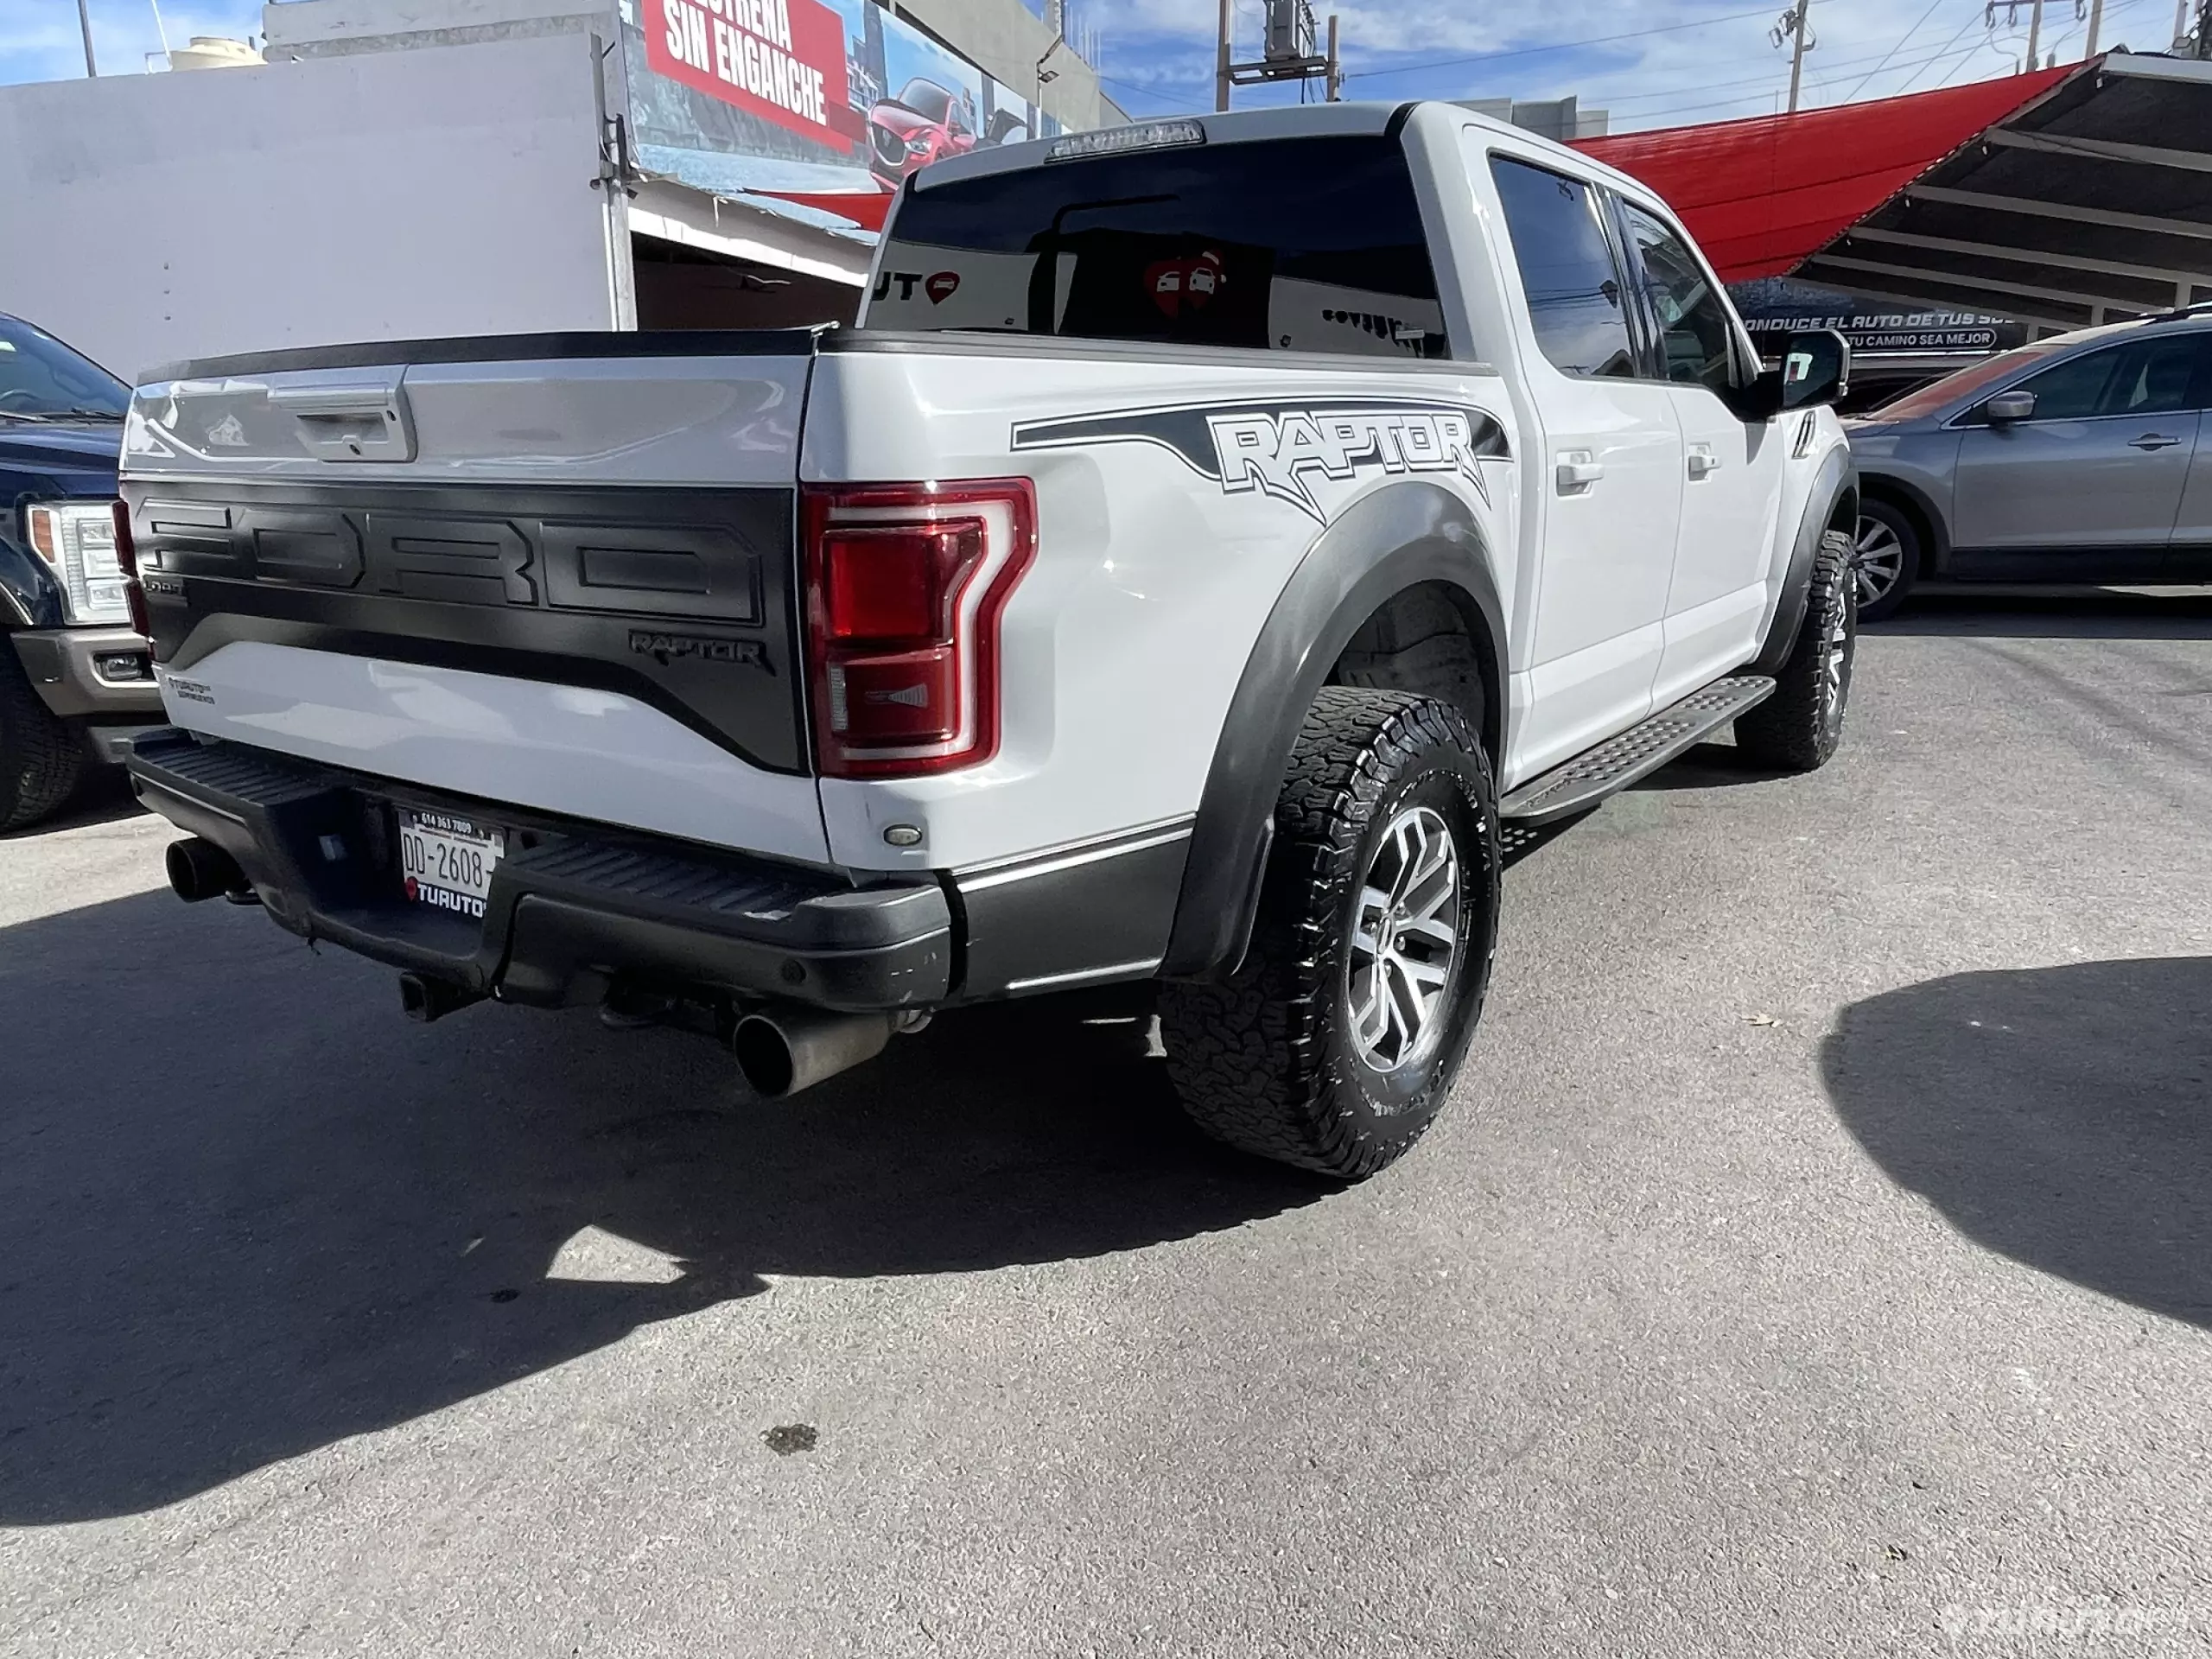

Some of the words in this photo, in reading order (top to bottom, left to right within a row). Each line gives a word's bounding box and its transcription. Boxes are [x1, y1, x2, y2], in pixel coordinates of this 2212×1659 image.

[663, 0, 710, 73] SIN
[713, 17, 827, 126] ENGANCHE
[1744, 317, 1822, 332] ONDUCE
[1825, 316, 1848, 330] EL
[1851, 315, 1904, 328] AUTO
[1905, 314, 1934, 327] DE
[1937, 313, 1975, 326] TUS
[1847, 336, 1864, 346] TU
[1866, 334, 1917, 346] CAMINO
[1919, 334, 1944, 345] SEA
[1946, 333, 1991, 345] MEJOR
[1206, 410, 1491, 528] RAPTOR
[136, 496, 765, 628] FORD
[628, 629, 777, 677] RAPTOR
